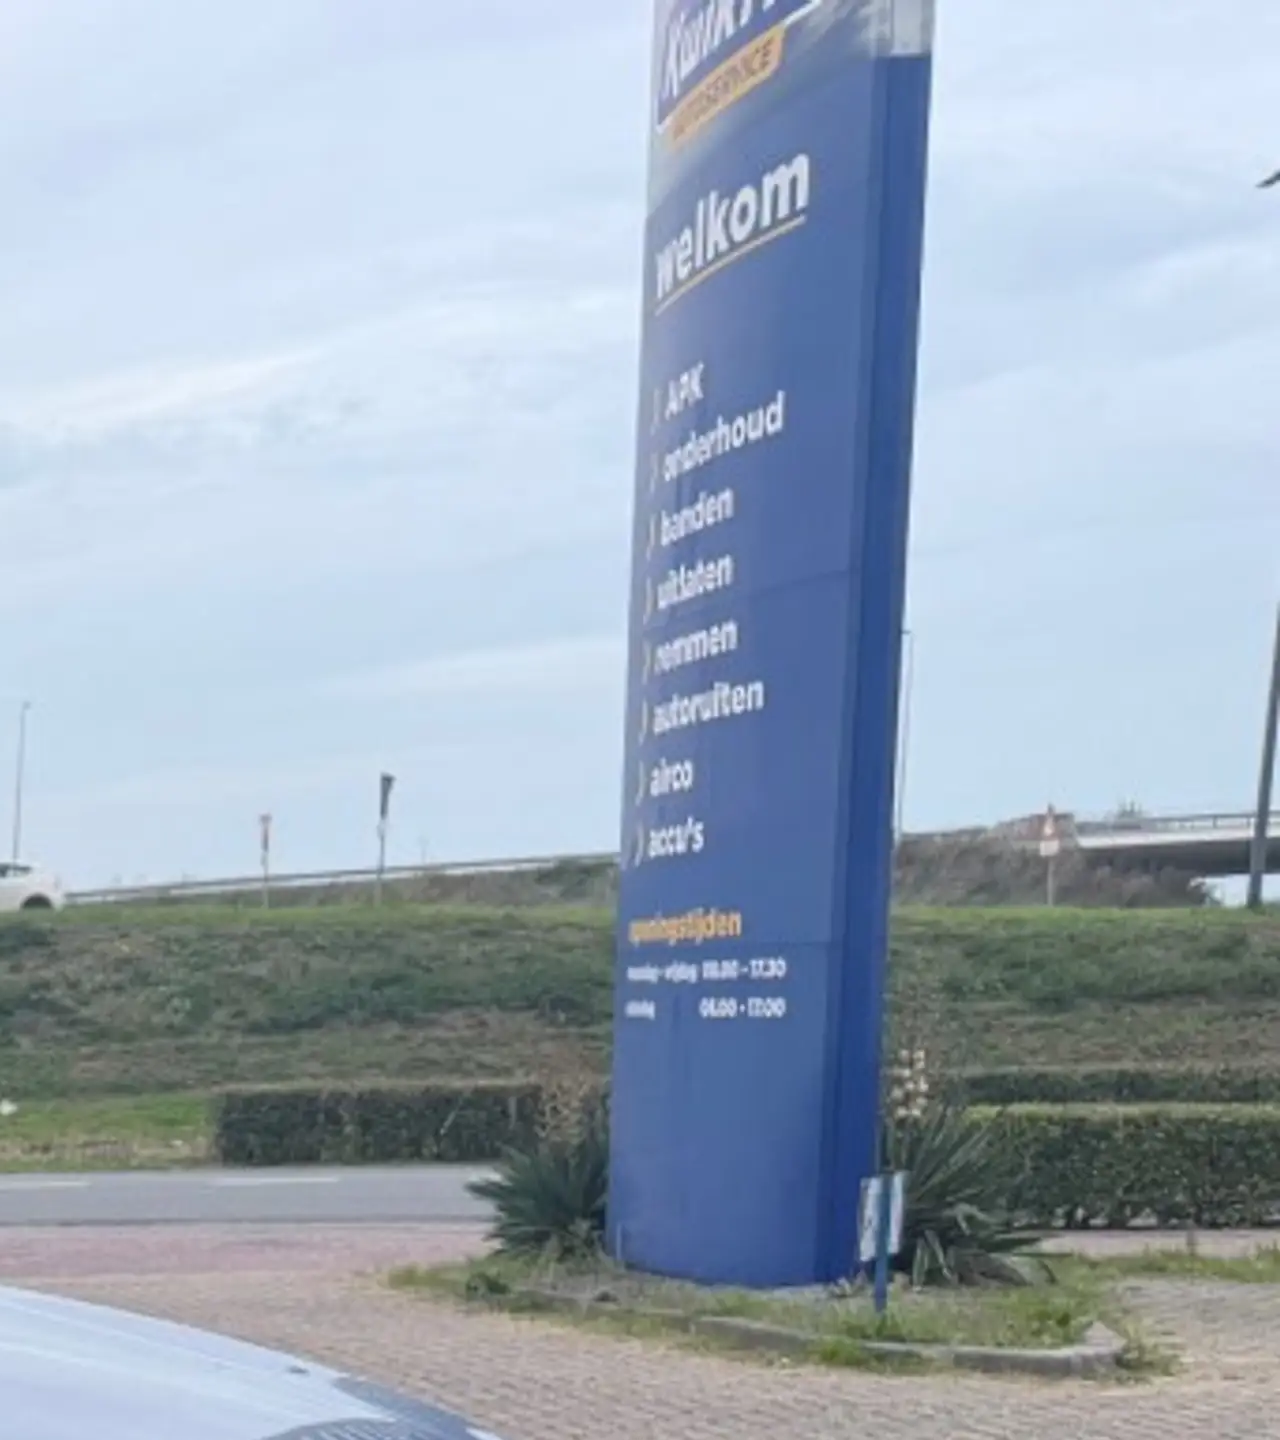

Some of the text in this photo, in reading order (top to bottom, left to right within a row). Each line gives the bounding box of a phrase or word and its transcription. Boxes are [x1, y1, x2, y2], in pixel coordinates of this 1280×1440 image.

[655, 153, 810, 300] welkom
[665, 362, 704, 421] APK
[663, 389, 786, 482] onderhoud
[660, 487, 734, 546] banden
[657, 554, 733, 610] uitlaten
[653, 619, 739, 674] remmen
[652, 680, 765, 735] autoruiten
[649, 757, 694, 797] airco
[648, 816, 704, 858] accu's
